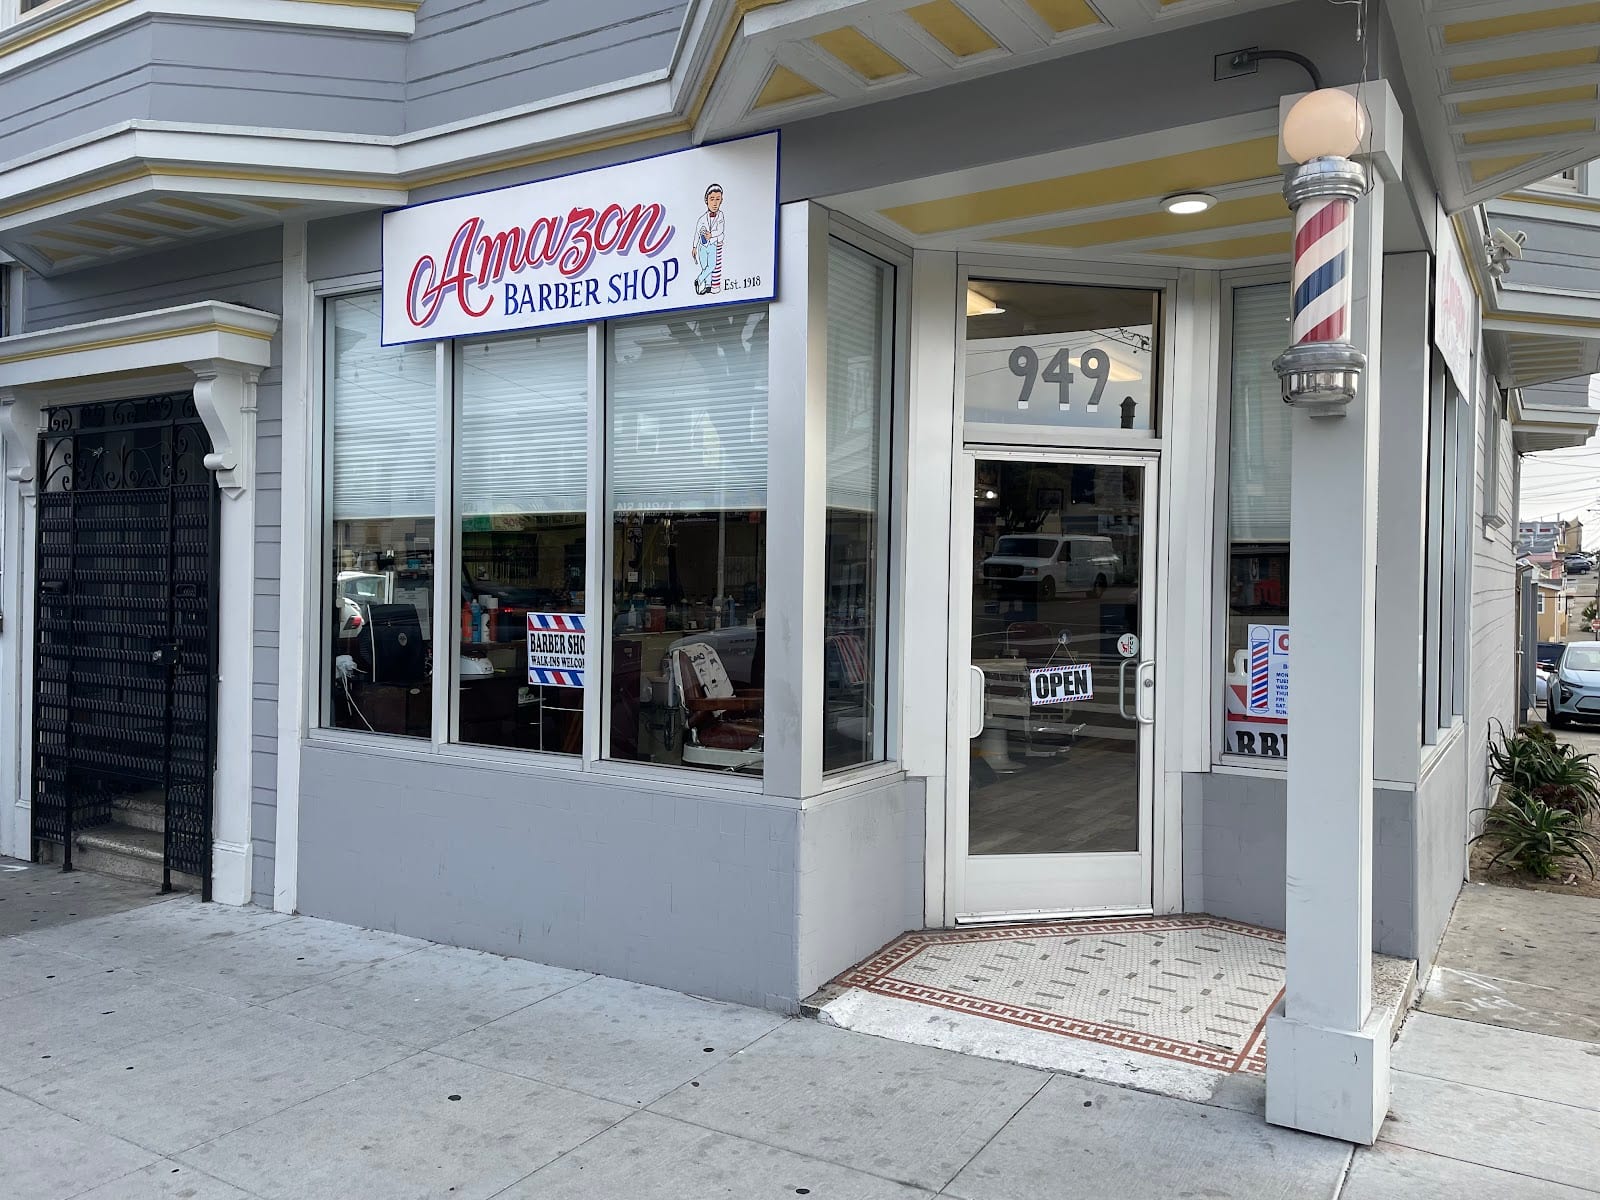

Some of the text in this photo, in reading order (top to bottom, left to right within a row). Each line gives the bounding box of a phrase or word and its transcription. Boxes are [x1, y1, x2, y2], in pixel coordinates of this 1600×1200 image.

[406, 203, 673, 327] Amazon
[503, 257, 679, 316] BARBER SHOP
[723, 275, 762, 291] Est. 1918
[1008, 345, 1111, 406] 949
[530, 633, 567, 655] BARBER
[531, 655, 560, 667] WALK-INS
[1035, 669, 1088, 700] OPEN
